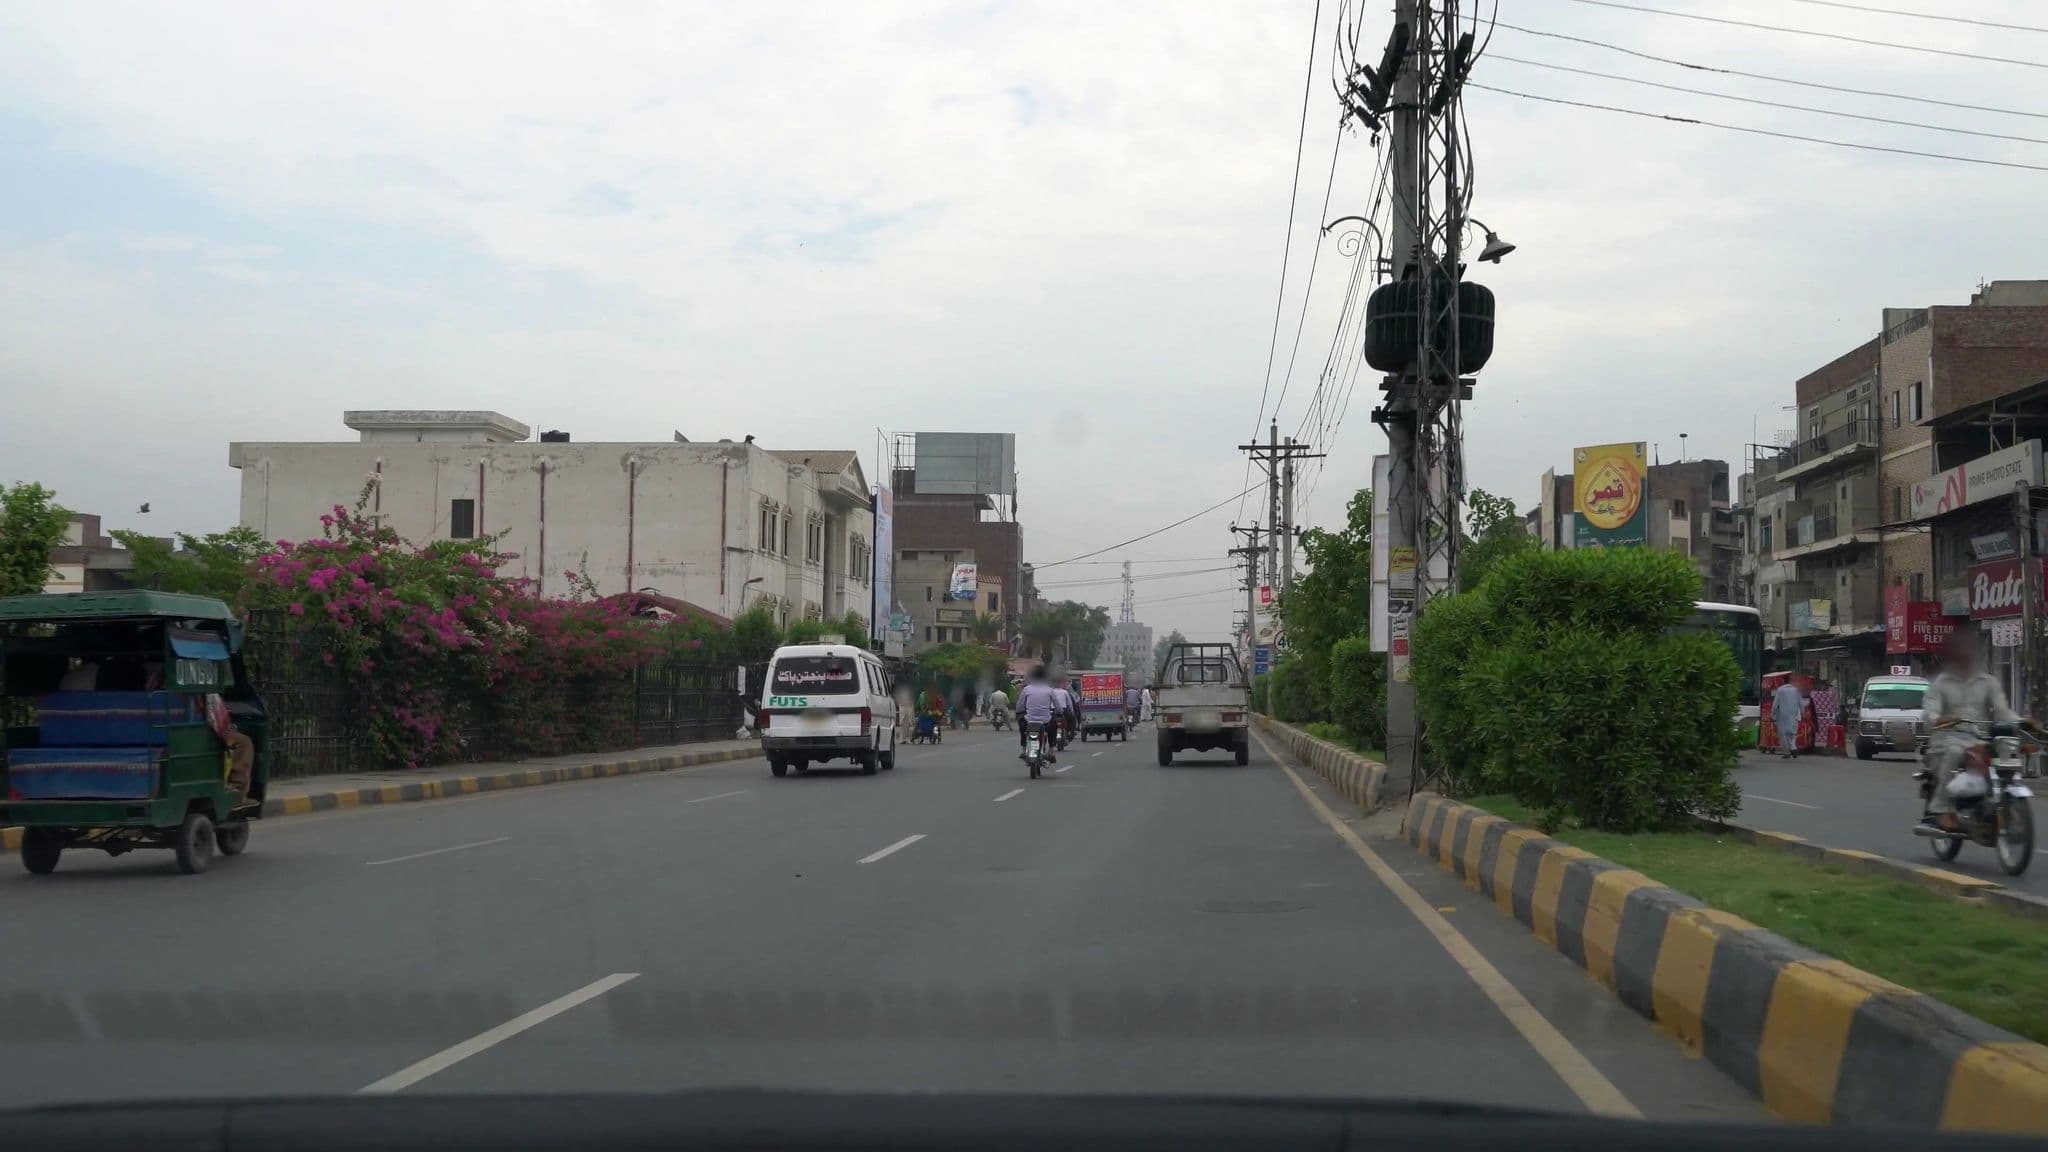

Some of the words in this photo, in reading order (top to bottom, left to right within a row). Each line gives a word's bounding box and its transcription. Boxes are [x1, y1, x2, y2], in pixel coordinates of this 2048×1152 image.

[1968, 472, 1986, 488] PRIME
[1986, 466, 2005, 484] PHOTO
[2005, 460, 2022, 477] STATE
[1972, 568, 2024, 610] Bata
[1913, 624, 1932, 634] FIVE
[1933, 624, 1954, 634] STAR
[1923, 634, 1944, 644] FLEX
[1893, 666, 1908, 675] B-7
[769, 696, 808, 707] FUTS
